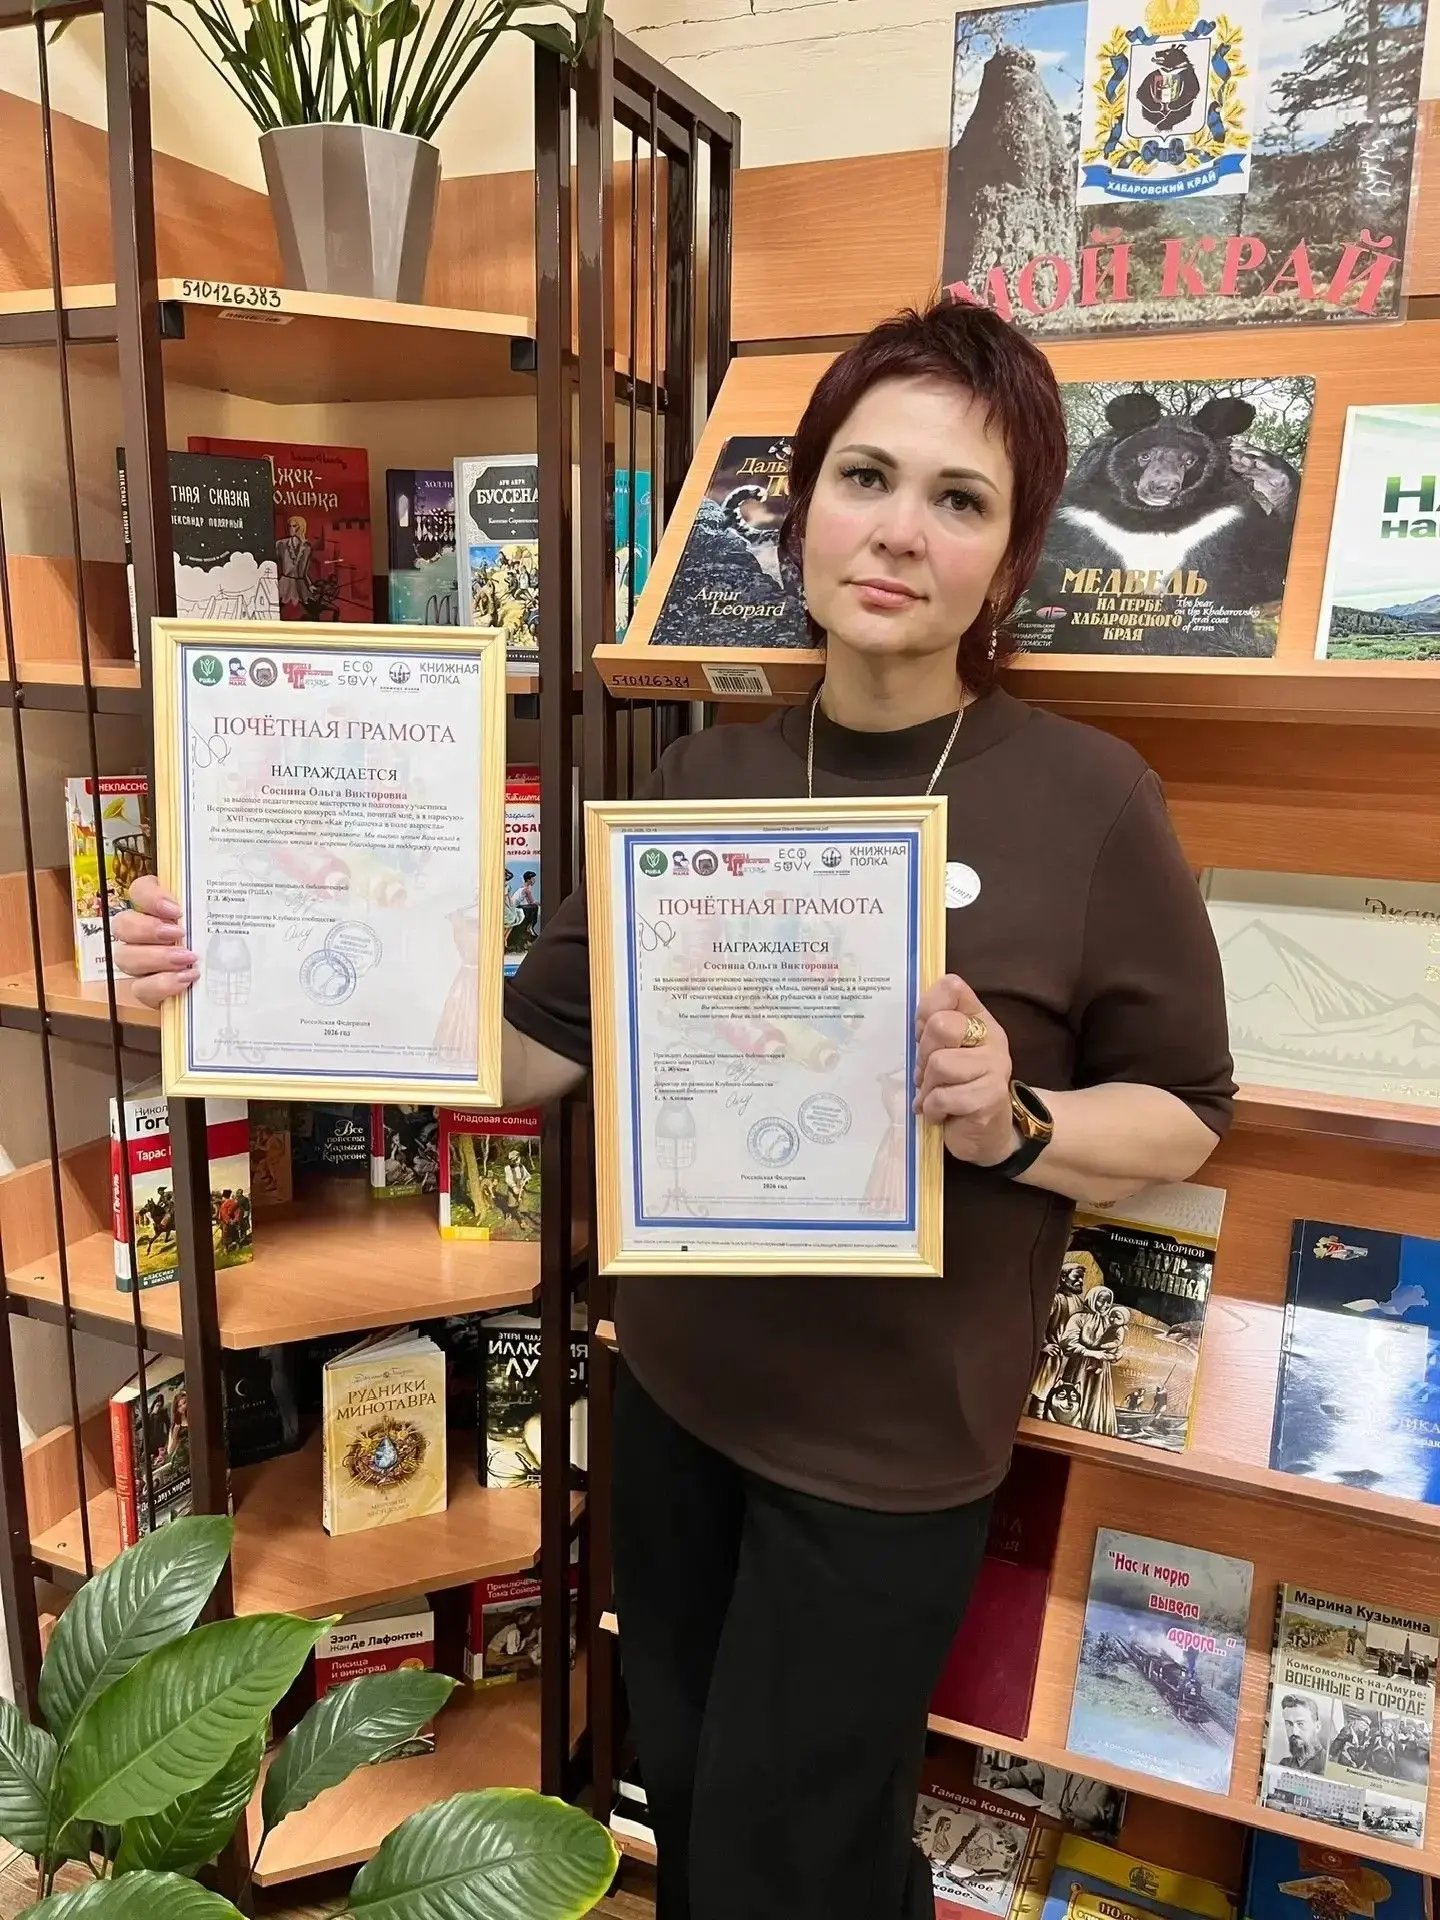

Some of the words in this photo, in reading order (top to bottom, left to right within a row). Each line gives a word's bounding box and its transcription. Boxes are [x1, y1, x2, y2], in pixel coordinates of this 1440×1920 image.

[1107, 177, 1185, 195] ХАБАРОВСКИЙ
[1187, 170, 1217, 191] КРАЙ
[943, 228, 1135, 322] МОЙ
[1160, 229, 1400, 316] КРАЙ
[182, 280, 281, 307] 510126383
[736, 457, 790, 477] Даль
[171, 485, 200, 503] ТНАЯ
[209, 488, 250, 507] СКАЗКА
[272, 490, 338, 512] оминка
[476, 486, 539, 504] БУССЕНА
[171, 514, 204, 528] ЕКСАНДР
[208, 517, 244, 529] ПОЛЯРНЫЙ
[1060, 568, 1208, 598] МЕДВЕДЬ
[694, 586, 741, 602] Amur
[710, 600, 786, 619] Leopard
[1096, 598, 1116, 611] НА
[1119, 598, 1163, 612] ГЕРБЕ
[1176, 597, 1192, 608] The
[1193, 597, 1214, 610] bear
[1174, 608, 1185, 616] on
[1187, 606, 1200, 617] the
[1070, 611, 1182, 628] ХАБАРОВСКОГО
[1182, 621, 1191, 633] of
[1192, 624, 1215, 632] arms
[1210, 616, 1229, 624] coat
[1103, 627, 1143, 642] КРАЯ
[343, 660, 373, 673] ECO
[419, 662, 479, 675] КНИЖНАЯ
[337, 675, 378, 687] SOVY
[419, 672, 460, 685] ПОЛКА
[612, 674, 690, 688] 510126381
[213, 714, 341, 740] ПОЧЁТНАЯ
[347, 721, 456, 743] ГРАМОТА
[271, 764, 397, 782] НАГРАЖДАЕТСЯ
[98, 781, 149, 793] НЕКЛАССНО
[261, 784, 306, 798] Соснина
[308, 786, 342, 800] Ольга
[345, 787, 407, 803] Викторовна
[206, 804, 263, 814] Всероссийского
[264, 807, 302, 815] семейного
[303, 808, 337, 818] конкурса
[262, 798, 318, 807] педагогическое
[319, 799, 361, 809] мастерство
[368, 801, 409, 811] подготовку
[410, 803, 448, 811] участника
[245, 816, 293, 825] тематическая
[294, 818, 323, 827] ступень
[505, 823, 540, 833] СОБА
[778, 847, 807, 860] ECO
[849, 845, 906, 857] КНИЖНАЯ
[774, 861, 811, 872] SOVY
[850, 856, 888, 867] ПОЛКА
[658, 895, 777, 916] ПОЧЁТНАЯ
[782, 897, 884, 916] ГРАМОТА
[712, 941, 829, 955] НАГРАЖДАЕТСЯ
[703, 961, 744, 971] Соснина
[747, 961, 778, 972] Ольга
[781, 961, 839, 973] Викторовна
[135, 1105, 168, 1116] Никол
[453, 1112, 501, 1125] Кладовая
[502, 1114, 538, 1126] солнца
[334, 1119, 364, 1136] Все
[136, 1149, 167, 1162] Тарас
[1110, 1232, 1149, 1247] Николай
[1153, 1240, 1205, 1258] ЗАДОРНОВ
[348, 1379, 426, 1404] РУДНИКИ
[337, 1393, 436, 1420] МИНОТАВРА
[1108, 1551, 1139, 1574] "Нас
[1141, 1563, 1150, 1576] к
[1154, 1567, 1190, 1588] морю
[488, 1590, 509, 1598] Тома
[1149, 1593, 1200, 1620] вывела
[1295, 1590, 1353, 1615] Марина
[1356, 1604, 1431, 1633] Кузьмина
[330, 1634, 357, 1644] Эзоп
[330, 1644, 349, 1652] Жан
[351, 1640, 366, 1650] де
[368, 1630, 423, 1647] Лафонтен
[1167, 1627, 1237, 1657] дорога..."
[331, 1659, 369, 1671] Лисица
[331, 1671, 338, 1679] и
[340, 1664, 387, 1678] виноград
[1286, 1657, 1427, 1700] Комсомольск-на-Амуре:
[1285, 1669, 1350, 1698] ВОЕННЫЕ
[1355, 1687, 1365, 1702] В
[1369, 1690, 1426, 1717] ГОРОДЕ
[931, 1784, 977, 1807] Тамара
[980, 1800, 1027, 1822] Коваль
